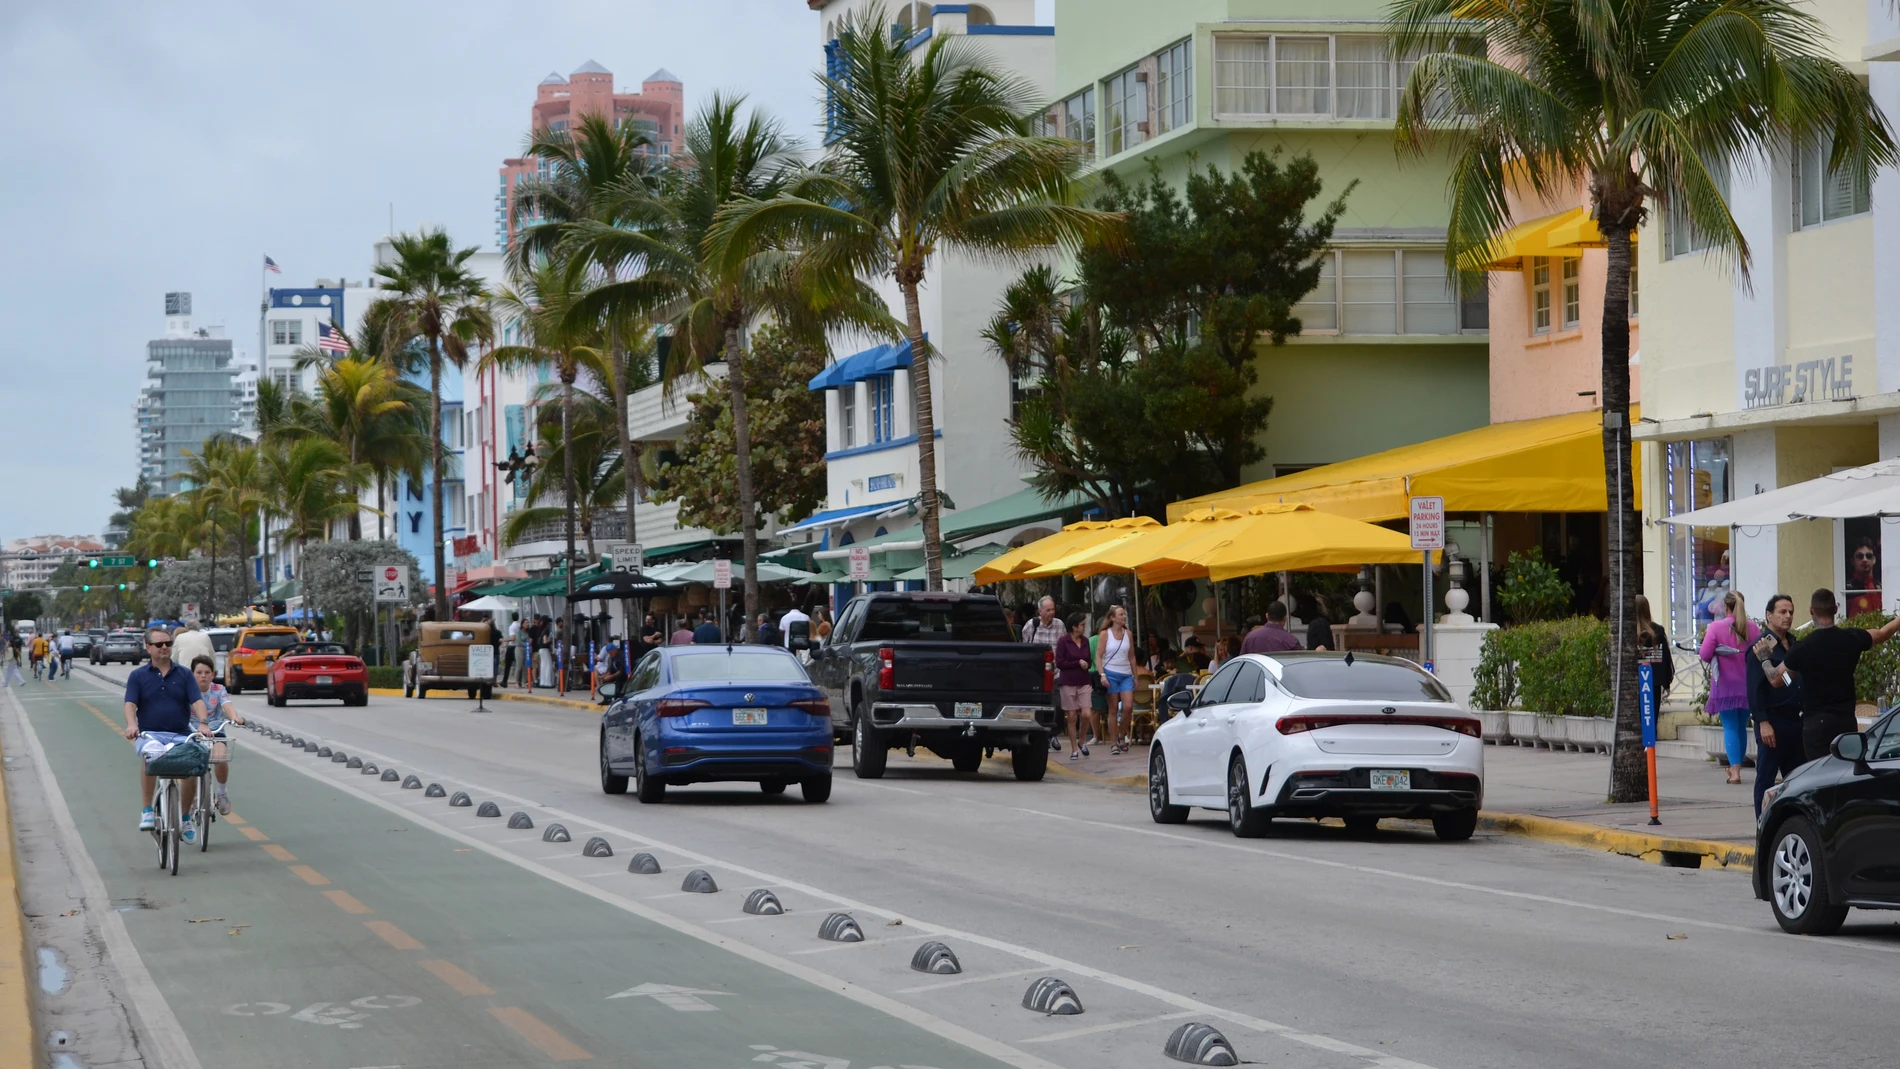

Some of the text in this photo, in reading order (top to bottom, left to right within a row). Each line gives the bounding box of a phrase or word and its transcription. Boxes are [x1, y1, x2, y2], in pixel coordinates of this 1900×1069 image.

[1745, 355, 1852, 401] SURF STYLE
[1413, 512, 1440, 520] PARKING
[1417, 501, 1436, 510] VALET
[1641, 671, 1651, 726] VALET
